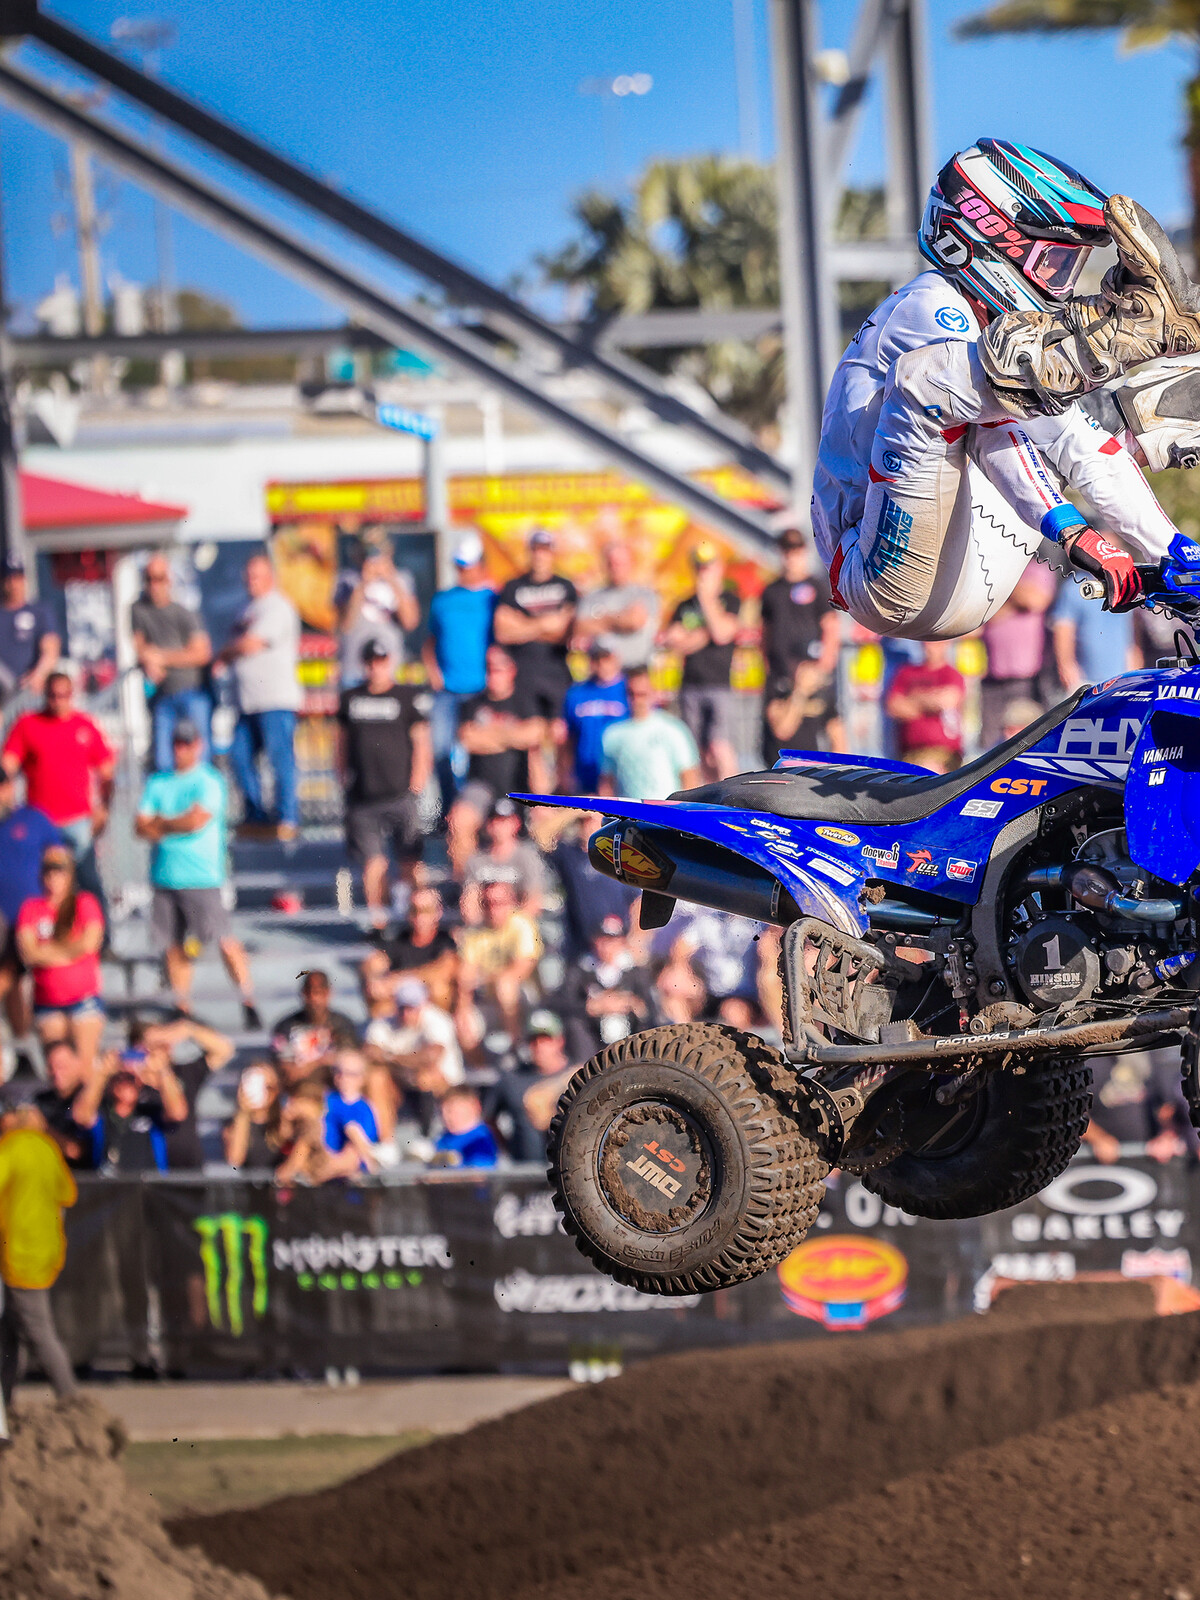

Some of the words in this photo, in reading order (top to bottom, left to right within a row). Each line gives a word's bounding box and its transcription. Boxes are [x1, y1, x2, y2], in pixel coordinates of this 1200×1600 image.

[951, 185, 1032, 259] 100%
[1143, 745, 1184, 765] YAMAHA
[990, 778, 1048, 796] CST
[823, 828, 842, 840] Twin
[840, 834, 855, 843] Air
[950, 864, 974, 877] DWT
[1042, 934, 1065, 970] 1
[1029, 973, 1081, 984] HINSON
[935, 1031, 1010, 1048] FACTORY43
[643, 1140, 687, 1173] CST
[626, 1154, 683, 1200] DWT
[1011, 1208, 1185, 1242] OAKLEY
[272, 1232, 453, 1273] MONSTER
